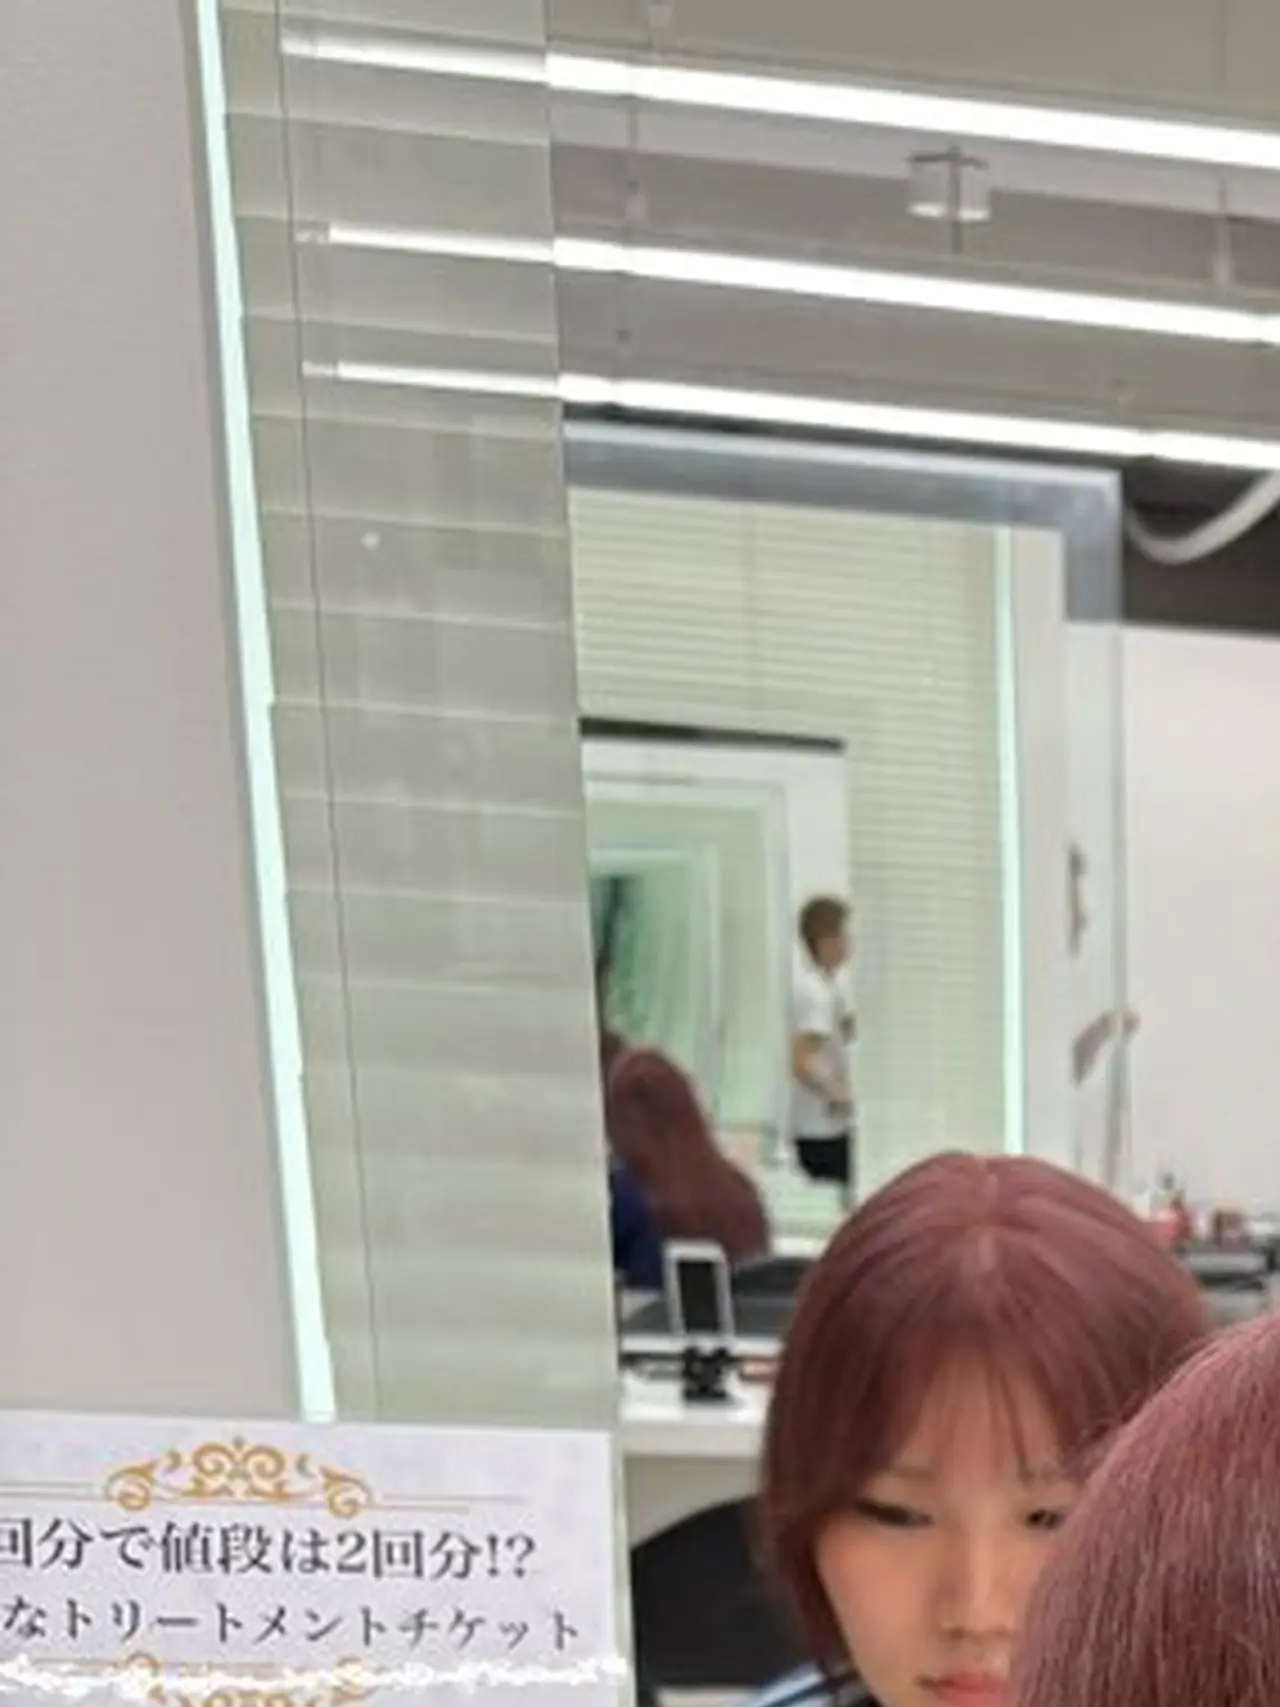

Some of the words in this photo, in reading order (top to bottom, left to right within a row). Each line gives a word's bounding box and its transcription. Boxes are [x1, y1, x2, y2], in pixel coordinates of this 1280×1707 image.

[3, 1595, 579, 1652] なトリートメントチケット
